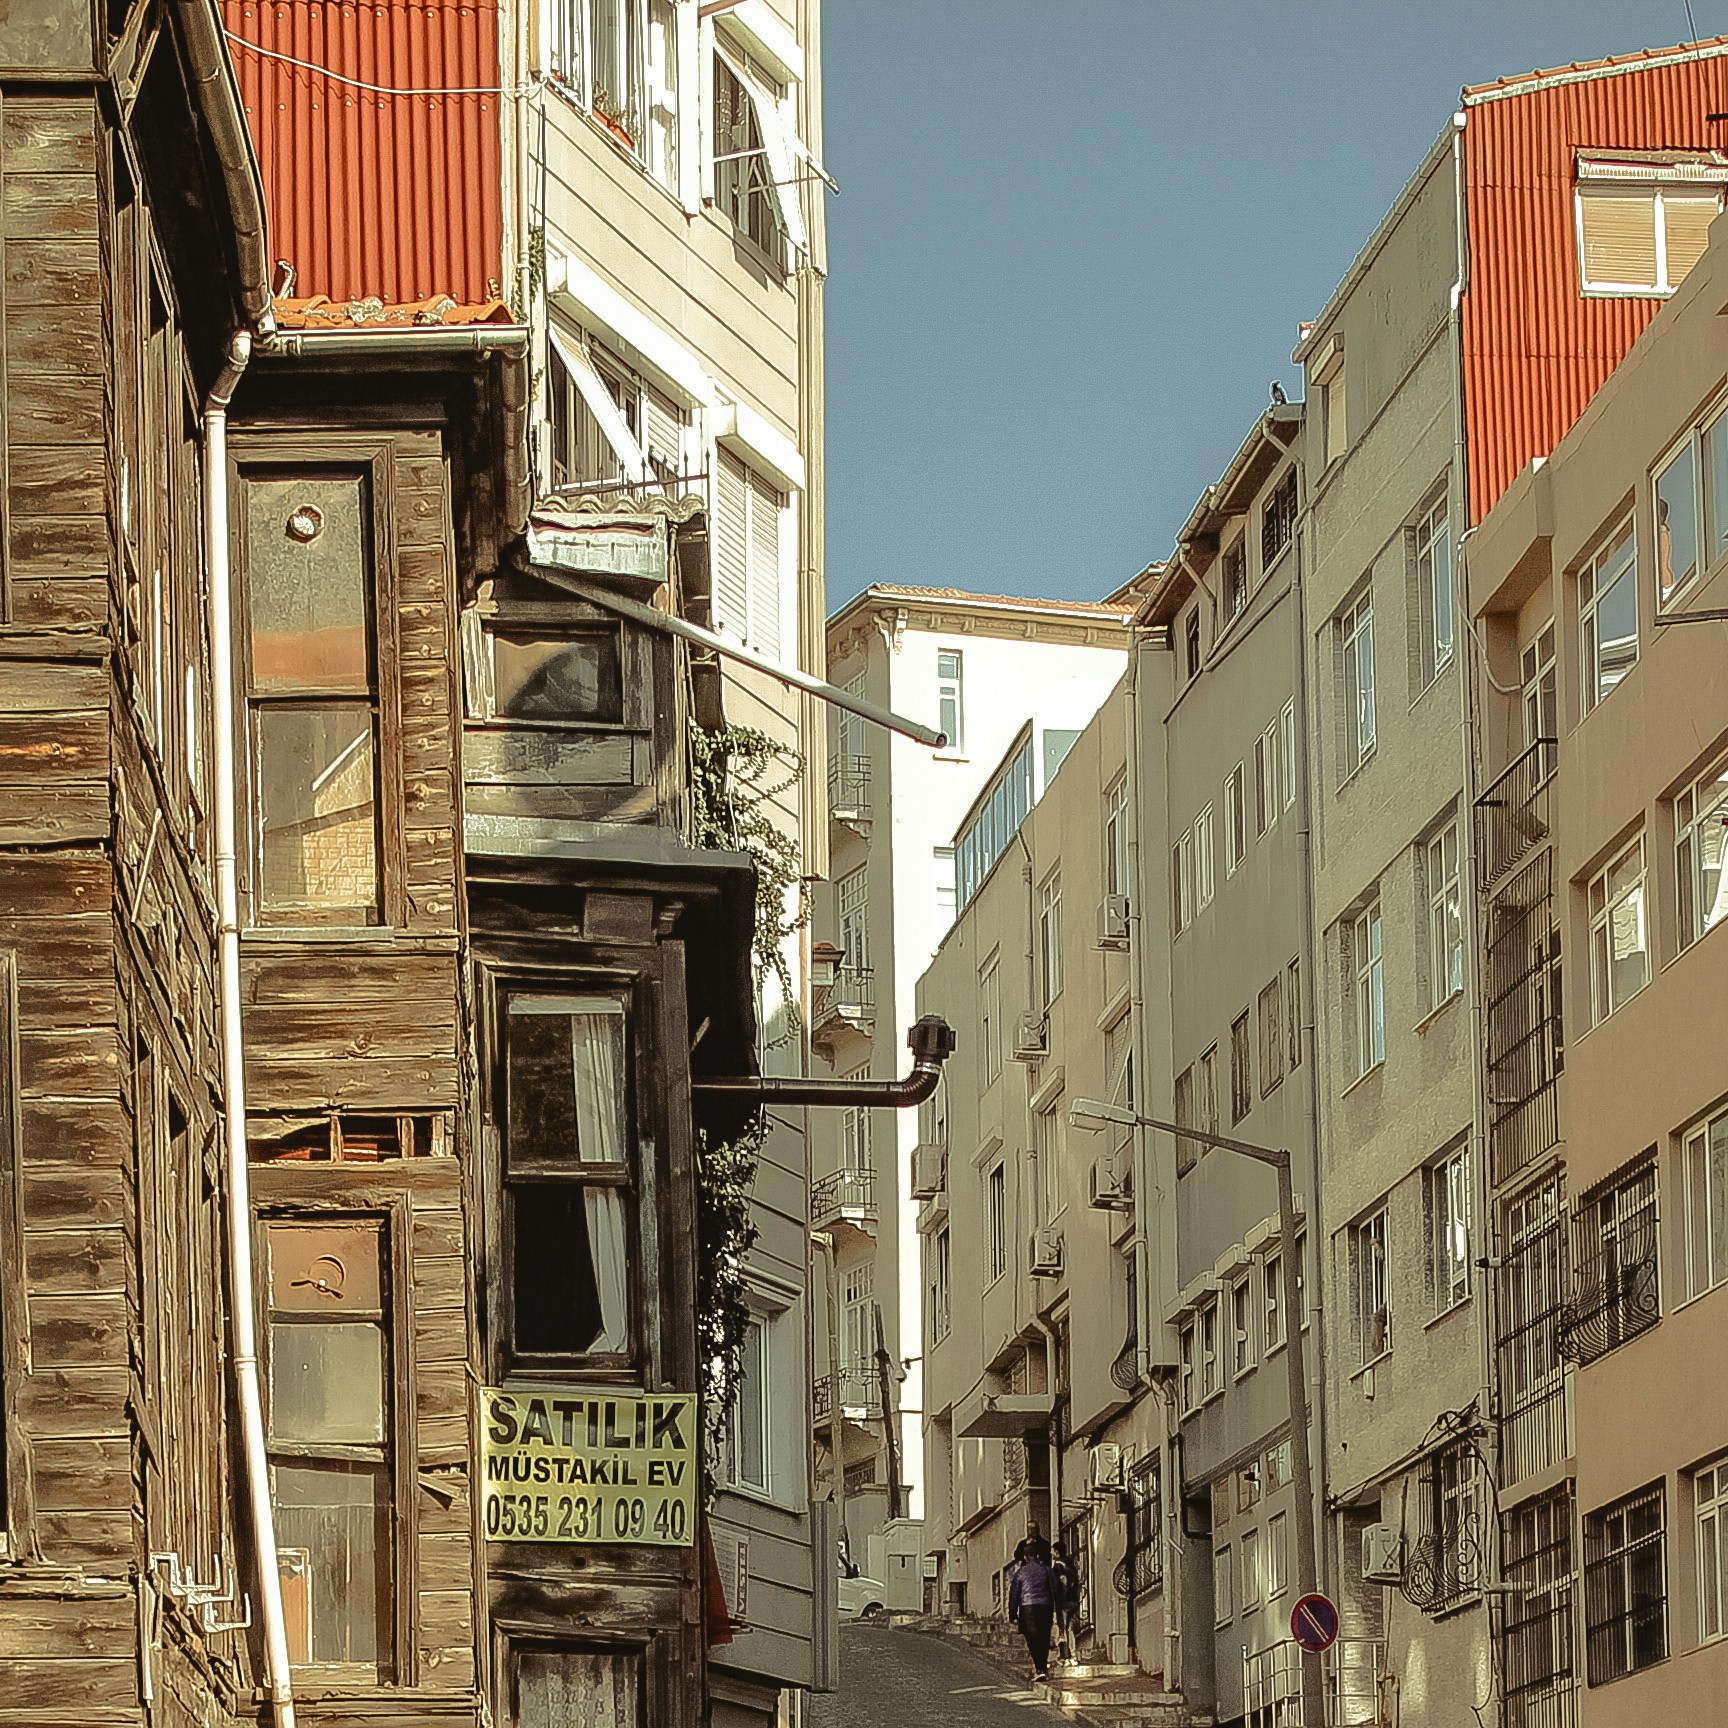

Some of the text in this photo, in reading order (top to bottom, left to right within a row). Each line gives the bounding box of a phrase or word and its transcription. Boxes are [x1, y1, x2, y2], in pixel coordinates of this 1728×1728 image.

[489, 1396, 688, 1450] SATILIK
[487, 1450, 687, 1487] MÜSTAKİL EV
[487, 1494, 686, 1540] 0535 231 09 40
